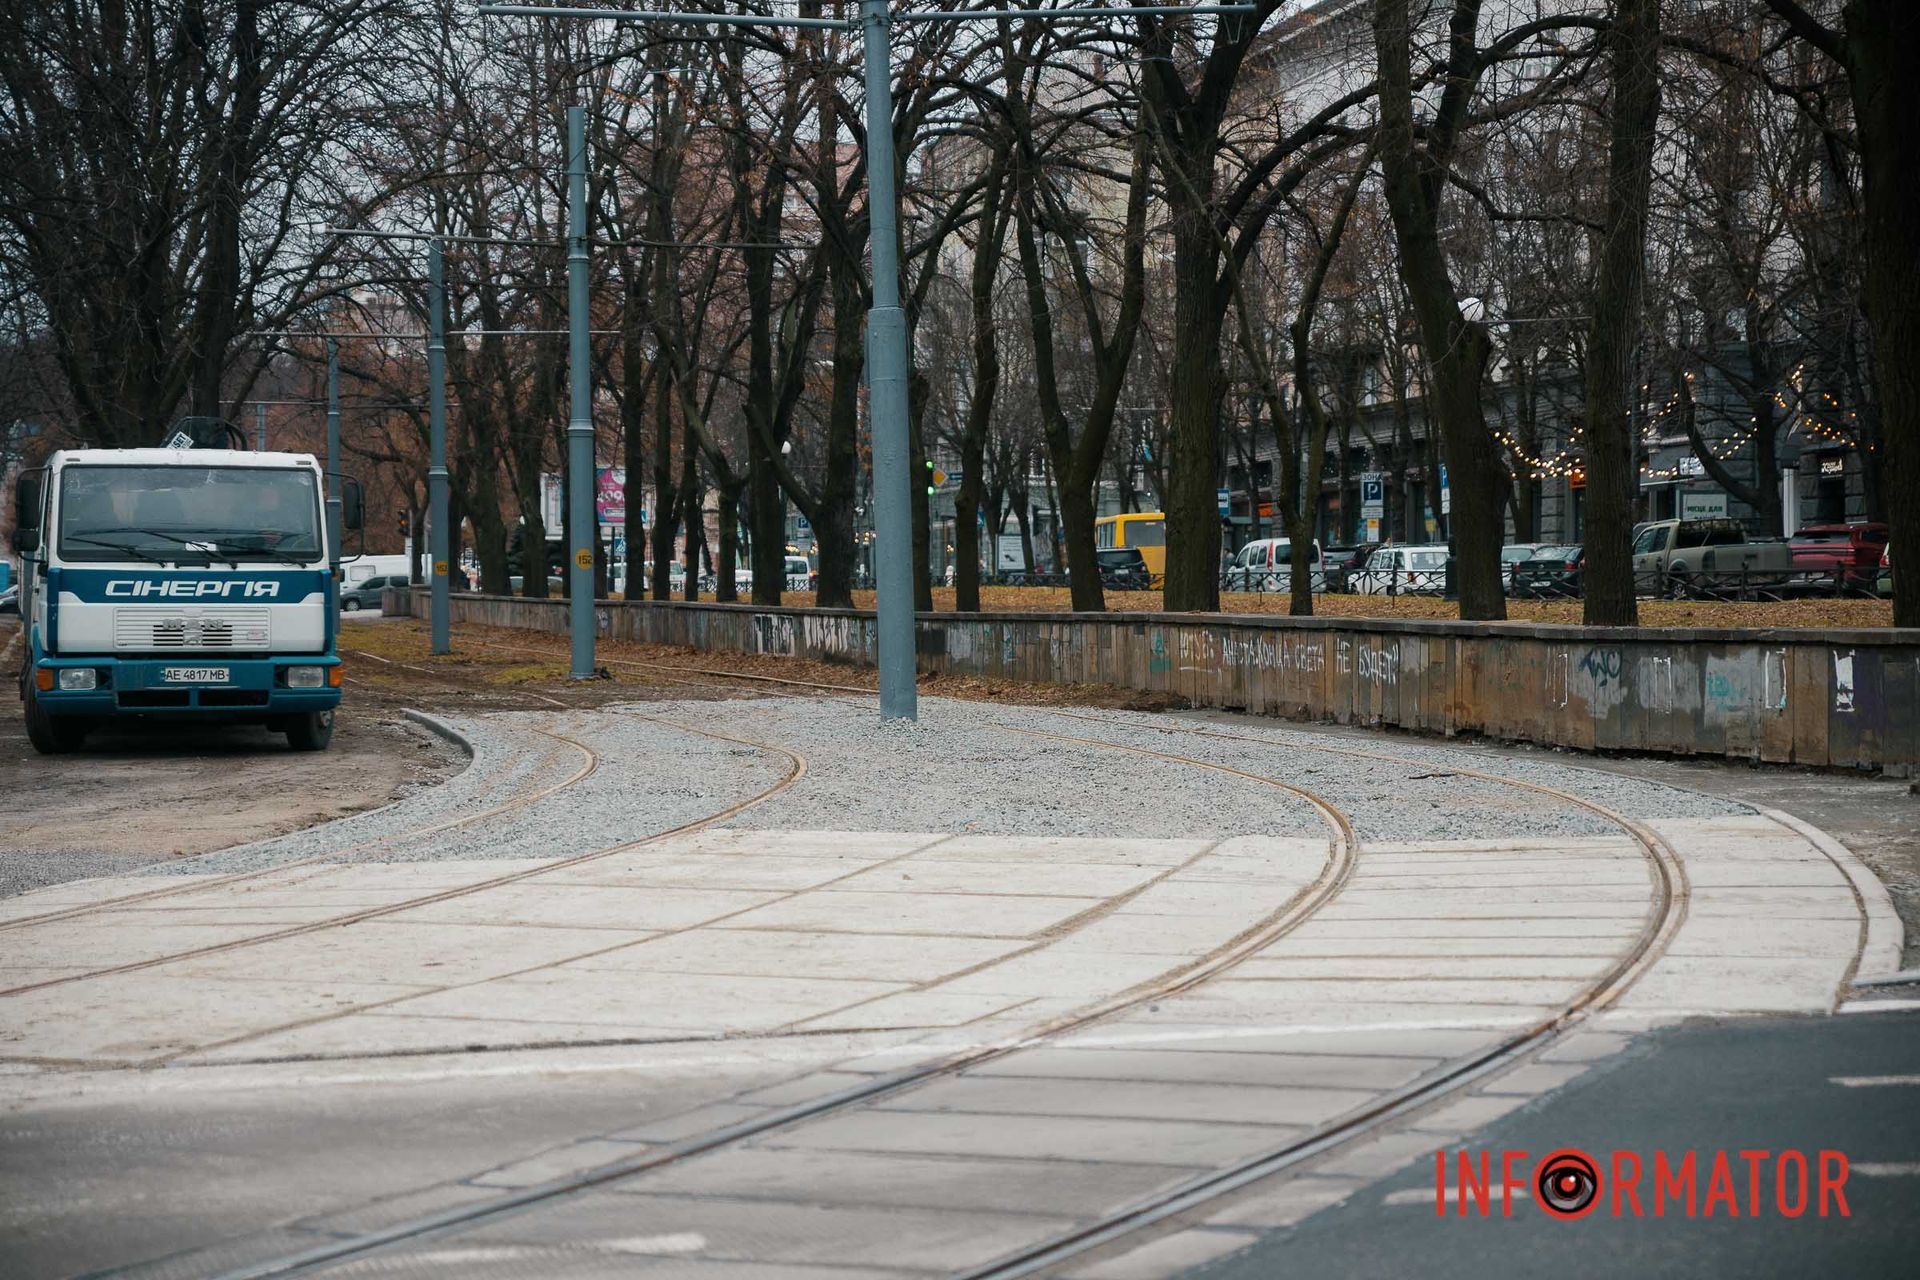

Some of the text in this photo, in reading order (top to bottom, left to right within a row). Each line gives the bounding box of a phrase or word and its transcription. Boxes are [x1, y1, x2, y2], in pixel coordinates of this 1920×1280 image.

[1362, 473, 1383, 481] ЗОНА
[1368, 483, 1378, 499] P
[578, 555, 592, 565] 152
[105, 580, 281, 597] СІНЕРГІЯ
[1336, 637, 1351, 674] НЕ
[165, 669, 226, 682] AE 4817 MB
